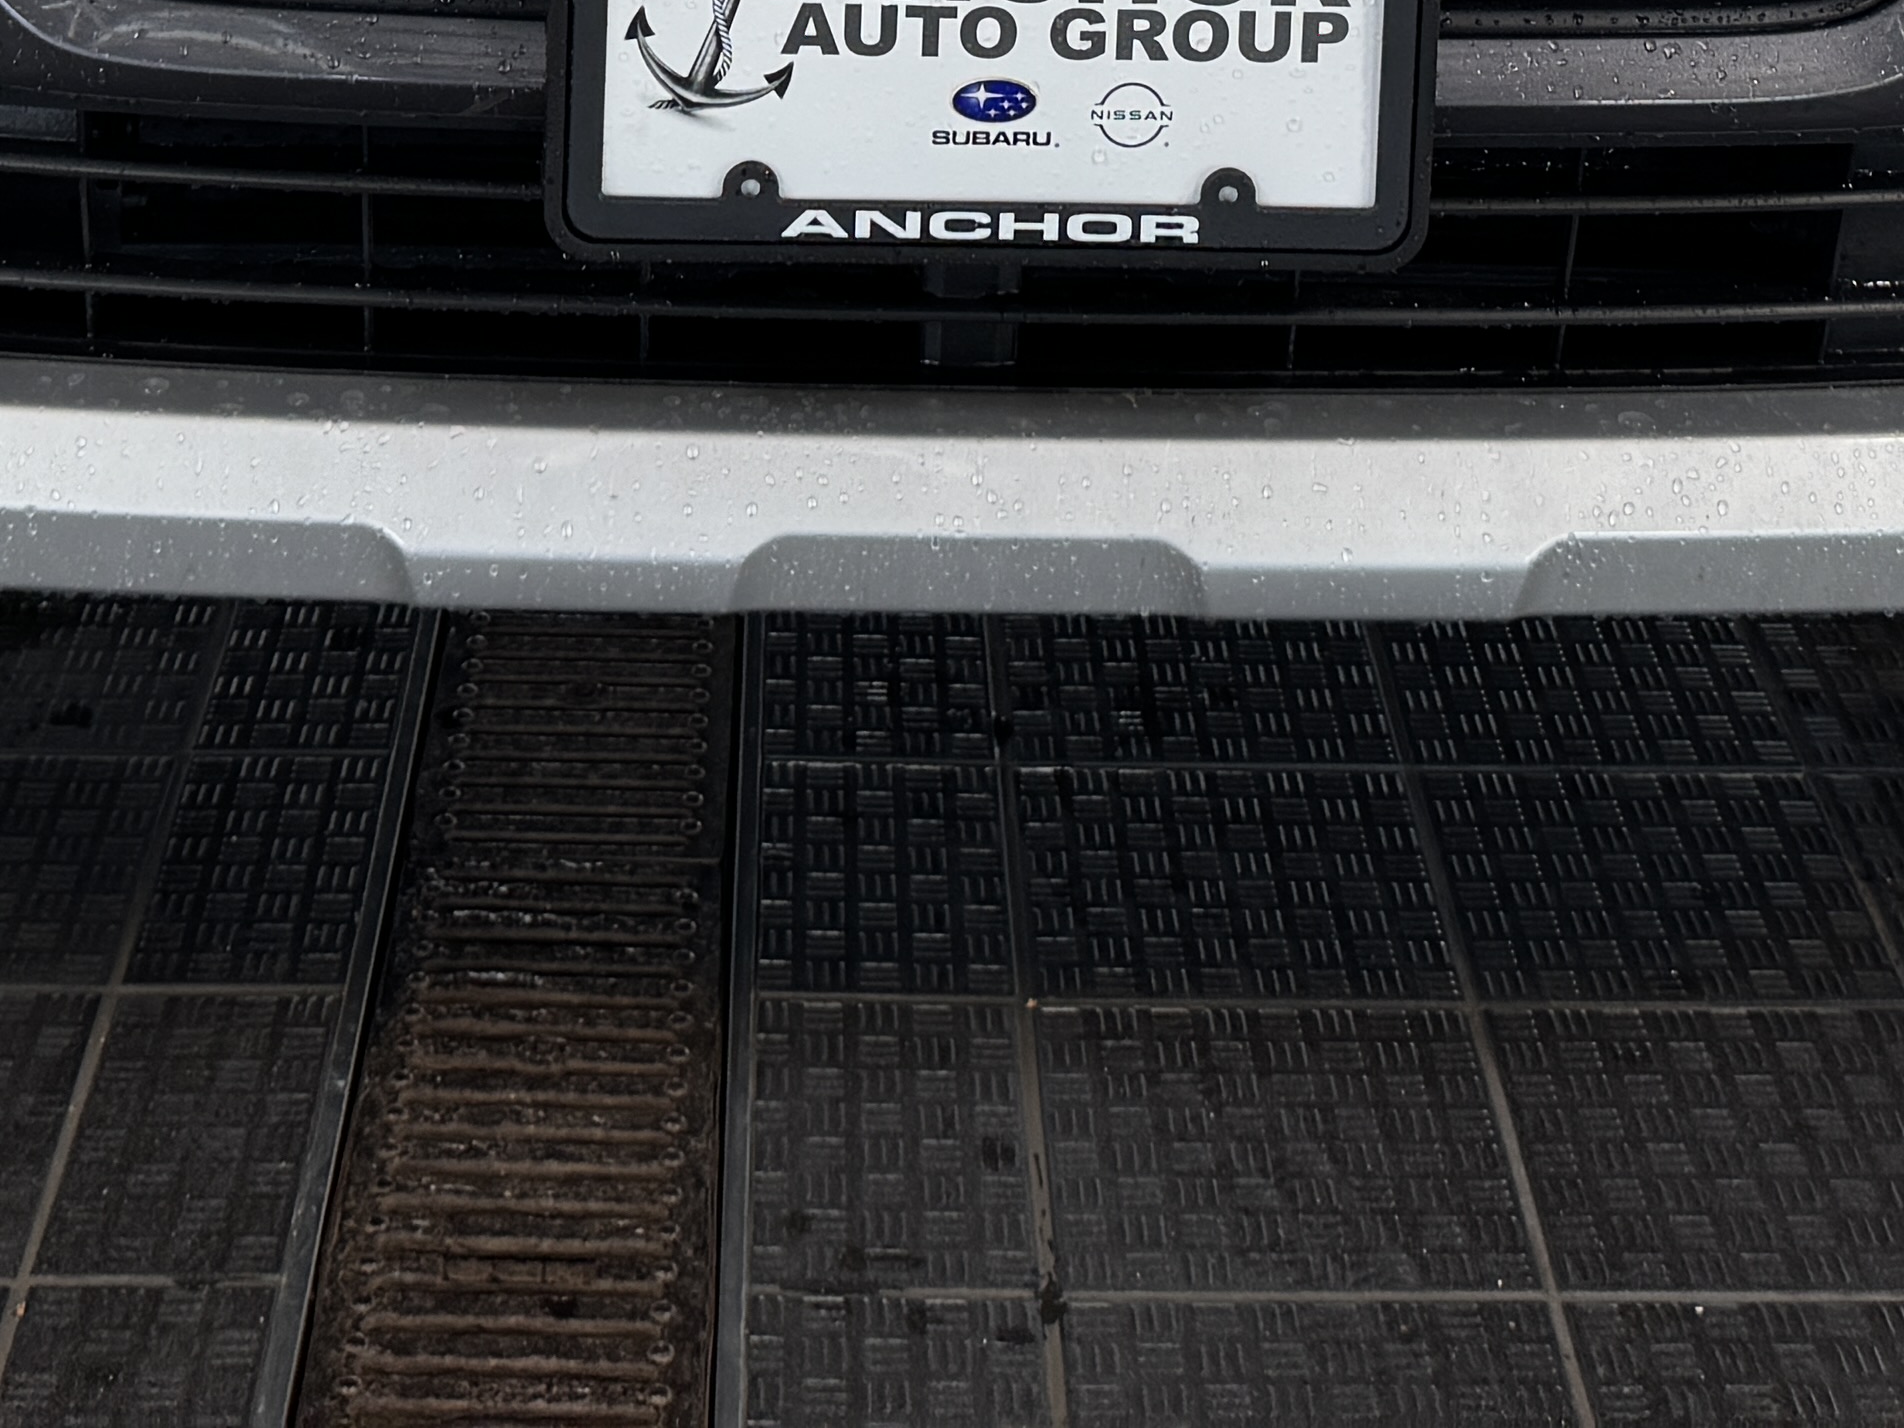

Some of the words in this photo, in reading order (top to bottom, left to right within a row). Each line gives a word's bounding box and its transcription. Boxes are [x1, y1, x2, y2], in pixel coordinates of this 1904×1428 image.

[780, 4, 1019, 59] AUTO
[1050, 8, 1350, 64] GROUP
[1090, 109, 1174, 122] NISSAN
[931, 129, 1052, 147] SUBARU
[780, 208, 1200, 246] ANCHOR
